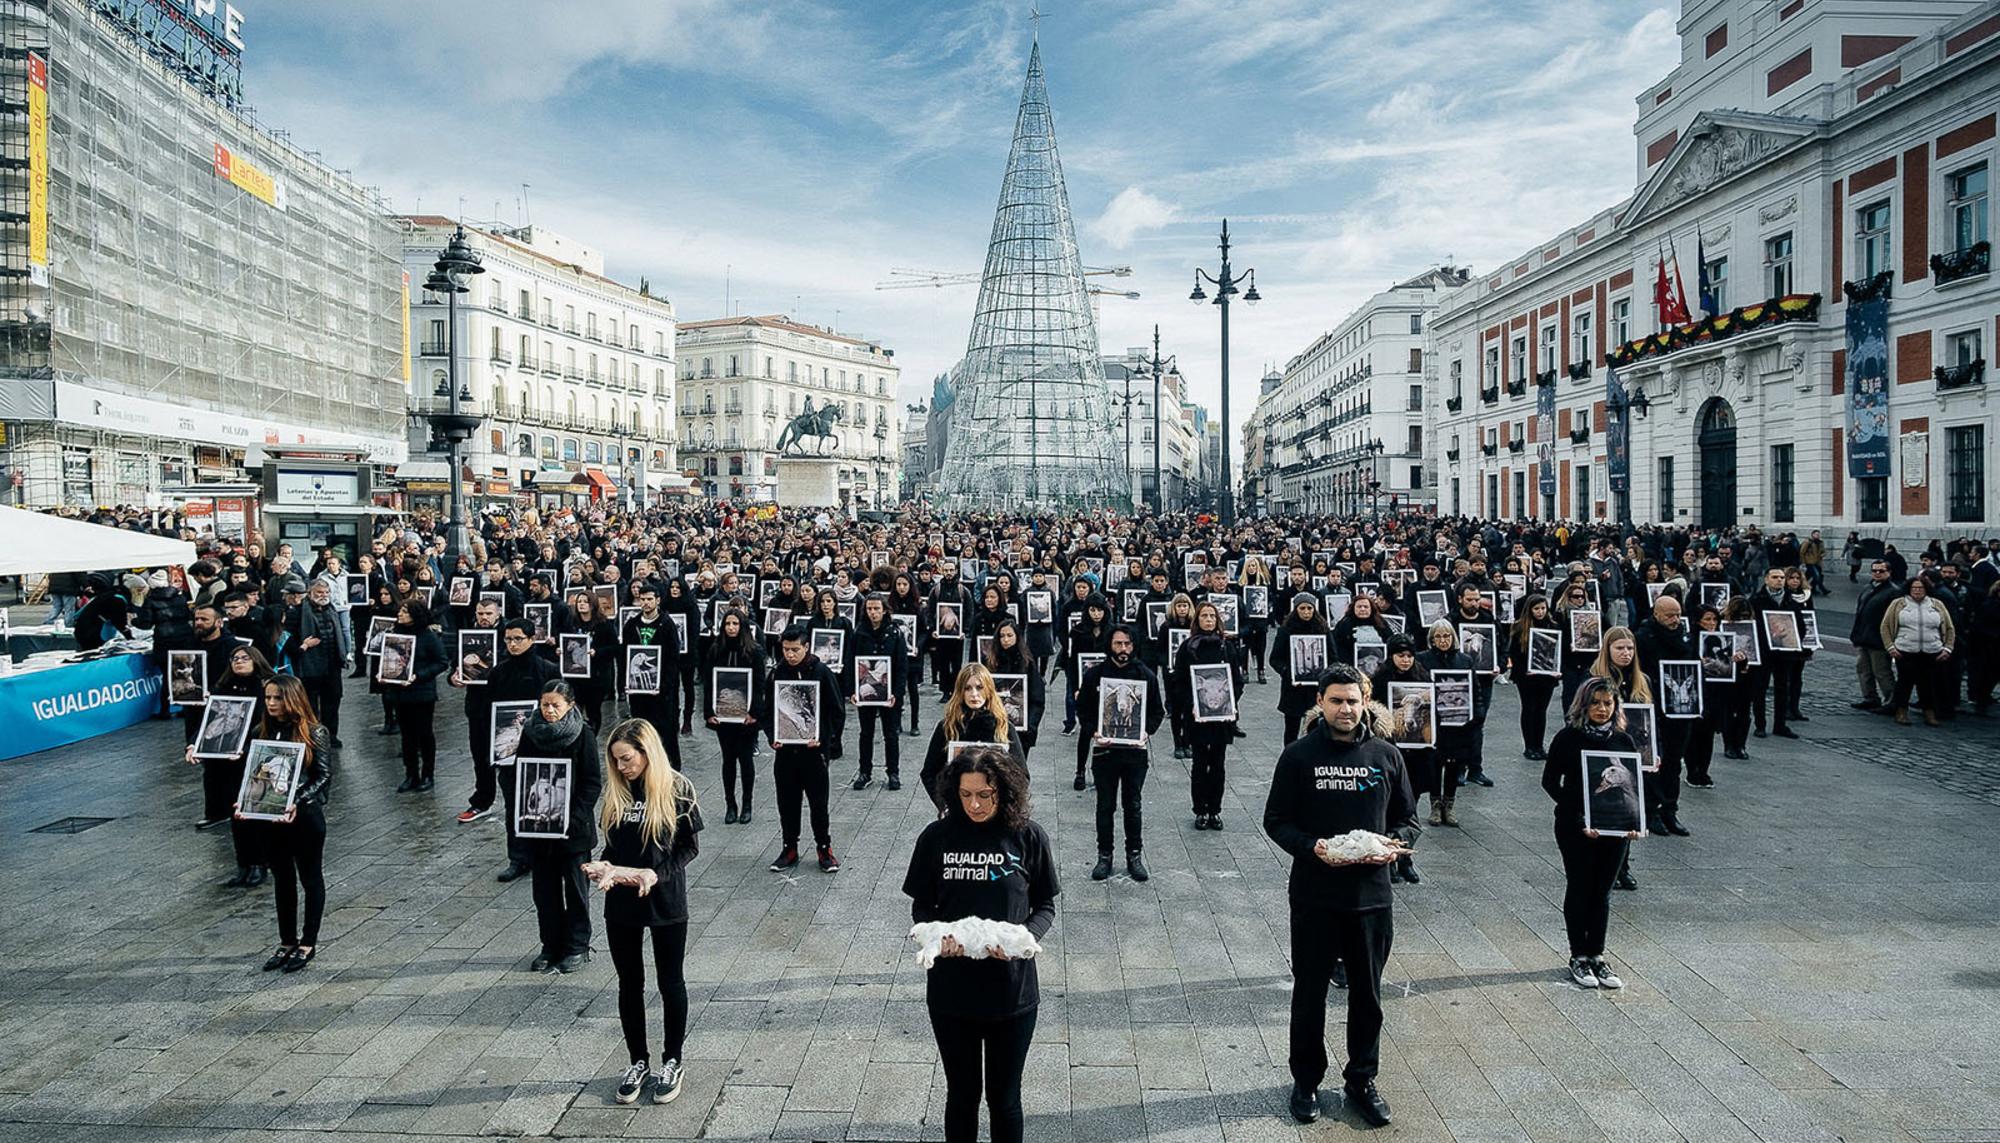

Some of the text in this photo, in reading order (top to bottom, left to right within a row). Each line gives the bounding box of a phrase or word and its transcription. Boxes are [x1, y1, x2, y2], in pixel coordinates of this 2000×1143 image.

[1314, 765, 1369, 777] IGUALDAD
[1315, 776, 1357, 790] animal
[943, 852, 1005, 865] IGUALDAD
[943, 863, 989, 881] animal
